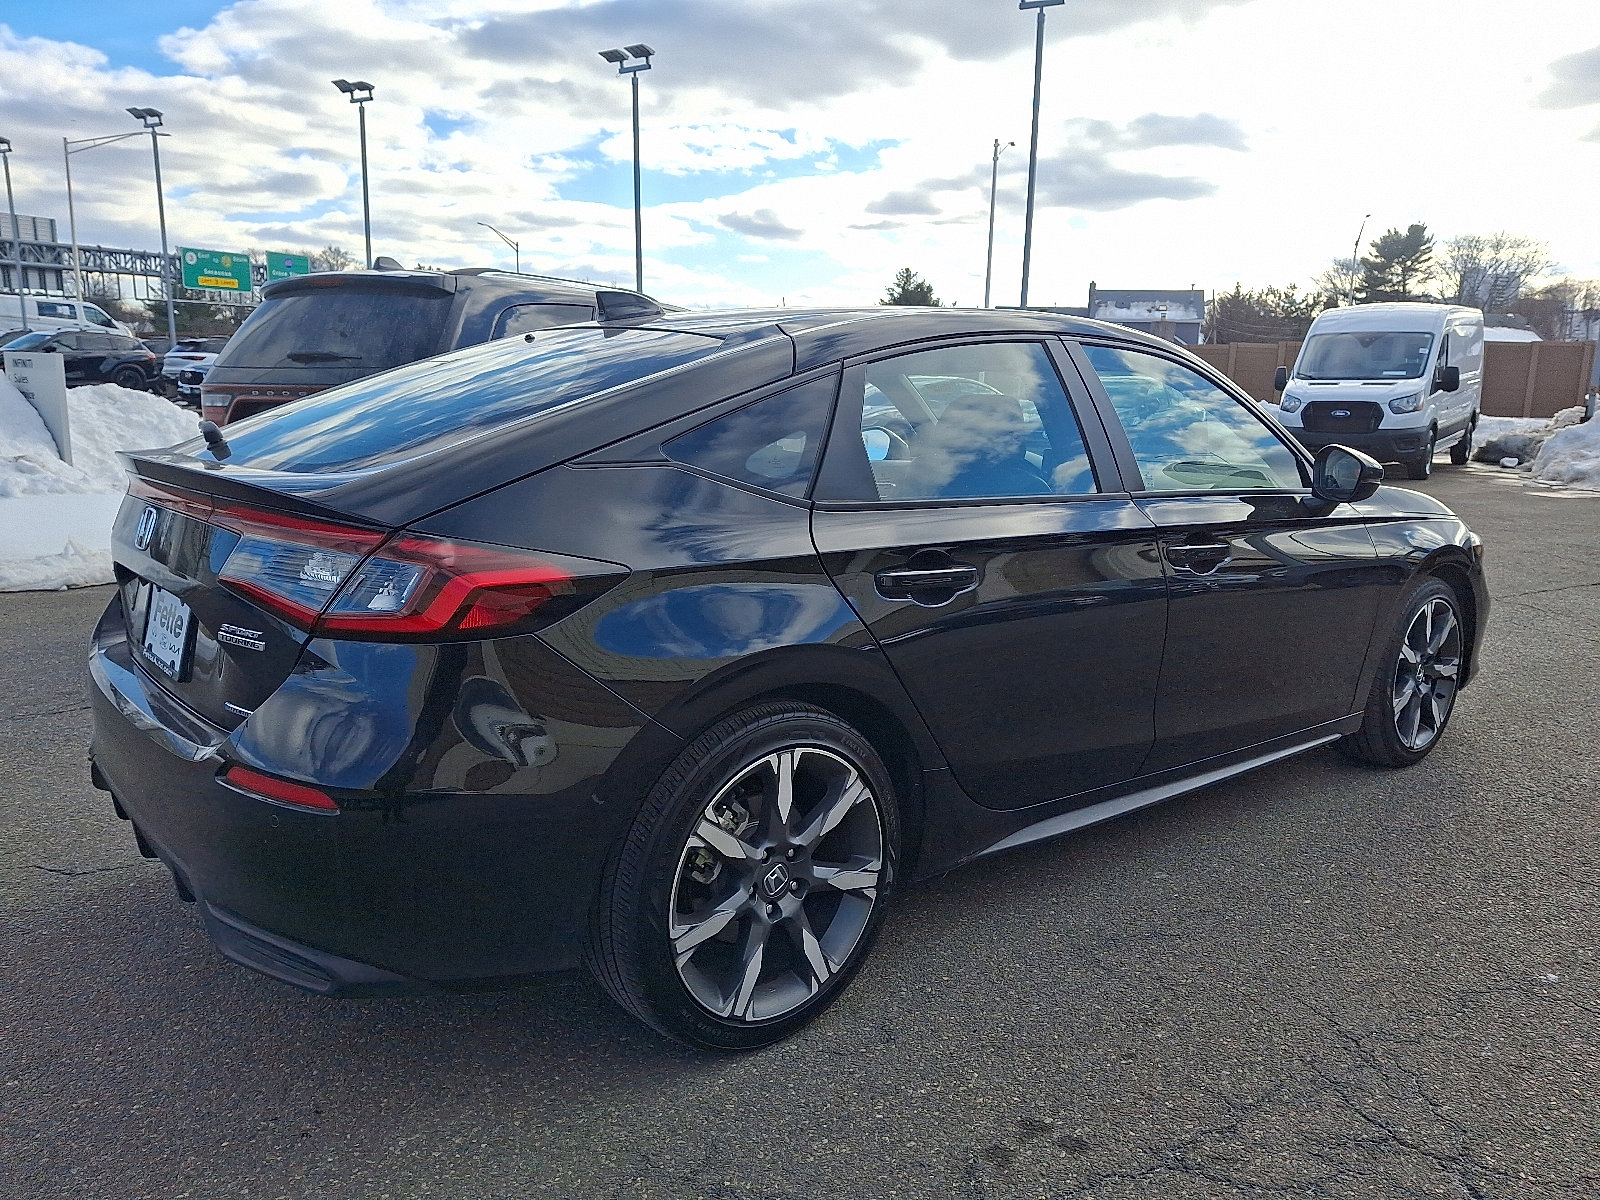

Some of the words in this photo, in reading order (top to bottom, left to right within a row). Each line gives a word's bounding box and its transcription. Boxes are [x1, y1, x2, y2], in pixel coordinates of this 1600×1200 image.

[153, 594, 184, 639] Fette
[219, 623, 263, 639] SPORT
[219, 632, 264, 650] TOURING
